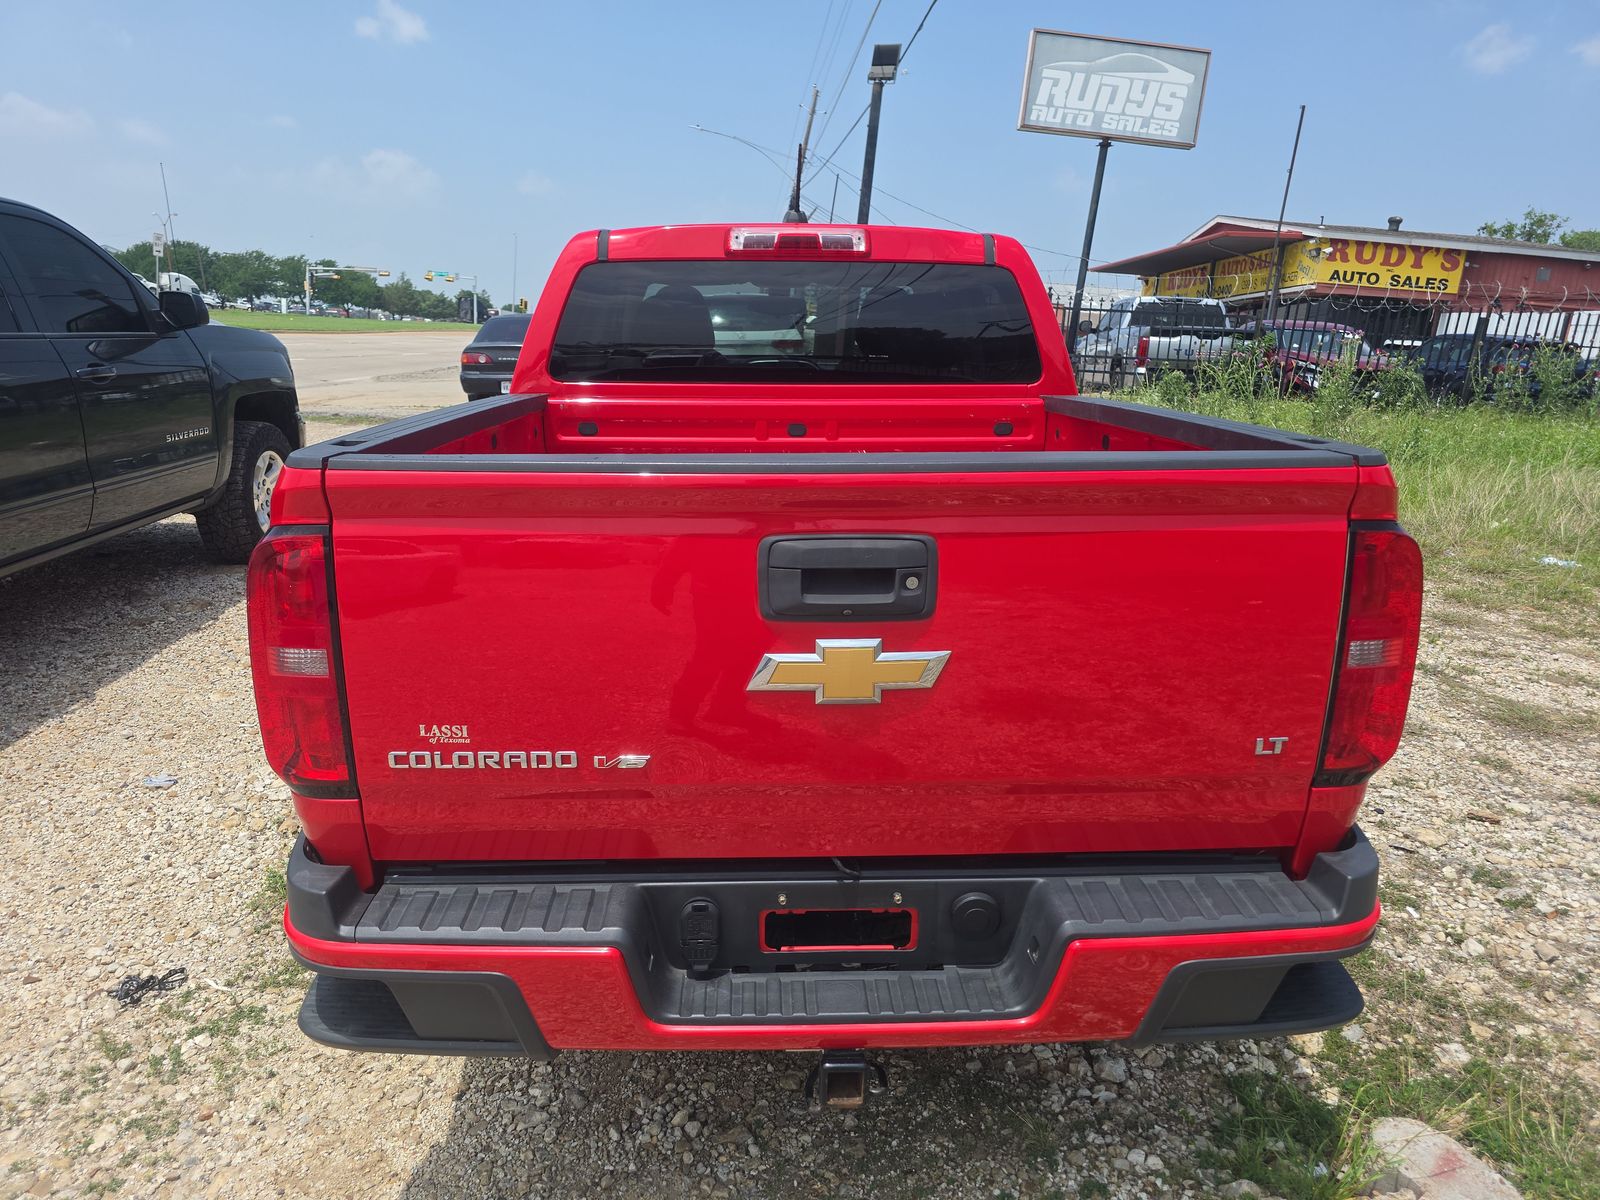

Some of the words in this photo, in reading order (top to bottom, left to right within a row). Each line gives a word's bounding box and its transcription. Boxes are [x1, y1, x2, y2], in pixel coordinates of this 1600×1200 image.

[1034, 68, 1189, 121] RUDYS
[1030, 105, 1094, 127] AUTO
[1101, 113, 1180, 137] SALES
[1326, 239, 1460, 272] RUDY'S
[1220, 257, 1248, 277] AUTO
[1328, 270, 1380, 285] AUTO
[1389, 274, 1449, 291] SALES
[166, 427, 209, 443] SILVERADO
[419, 724, 469, 738] LASSI
[429, 736, 438, 745] of
[1255, 736, 1289, 755] LT
[387, 750, 578, 769] COLORADO
